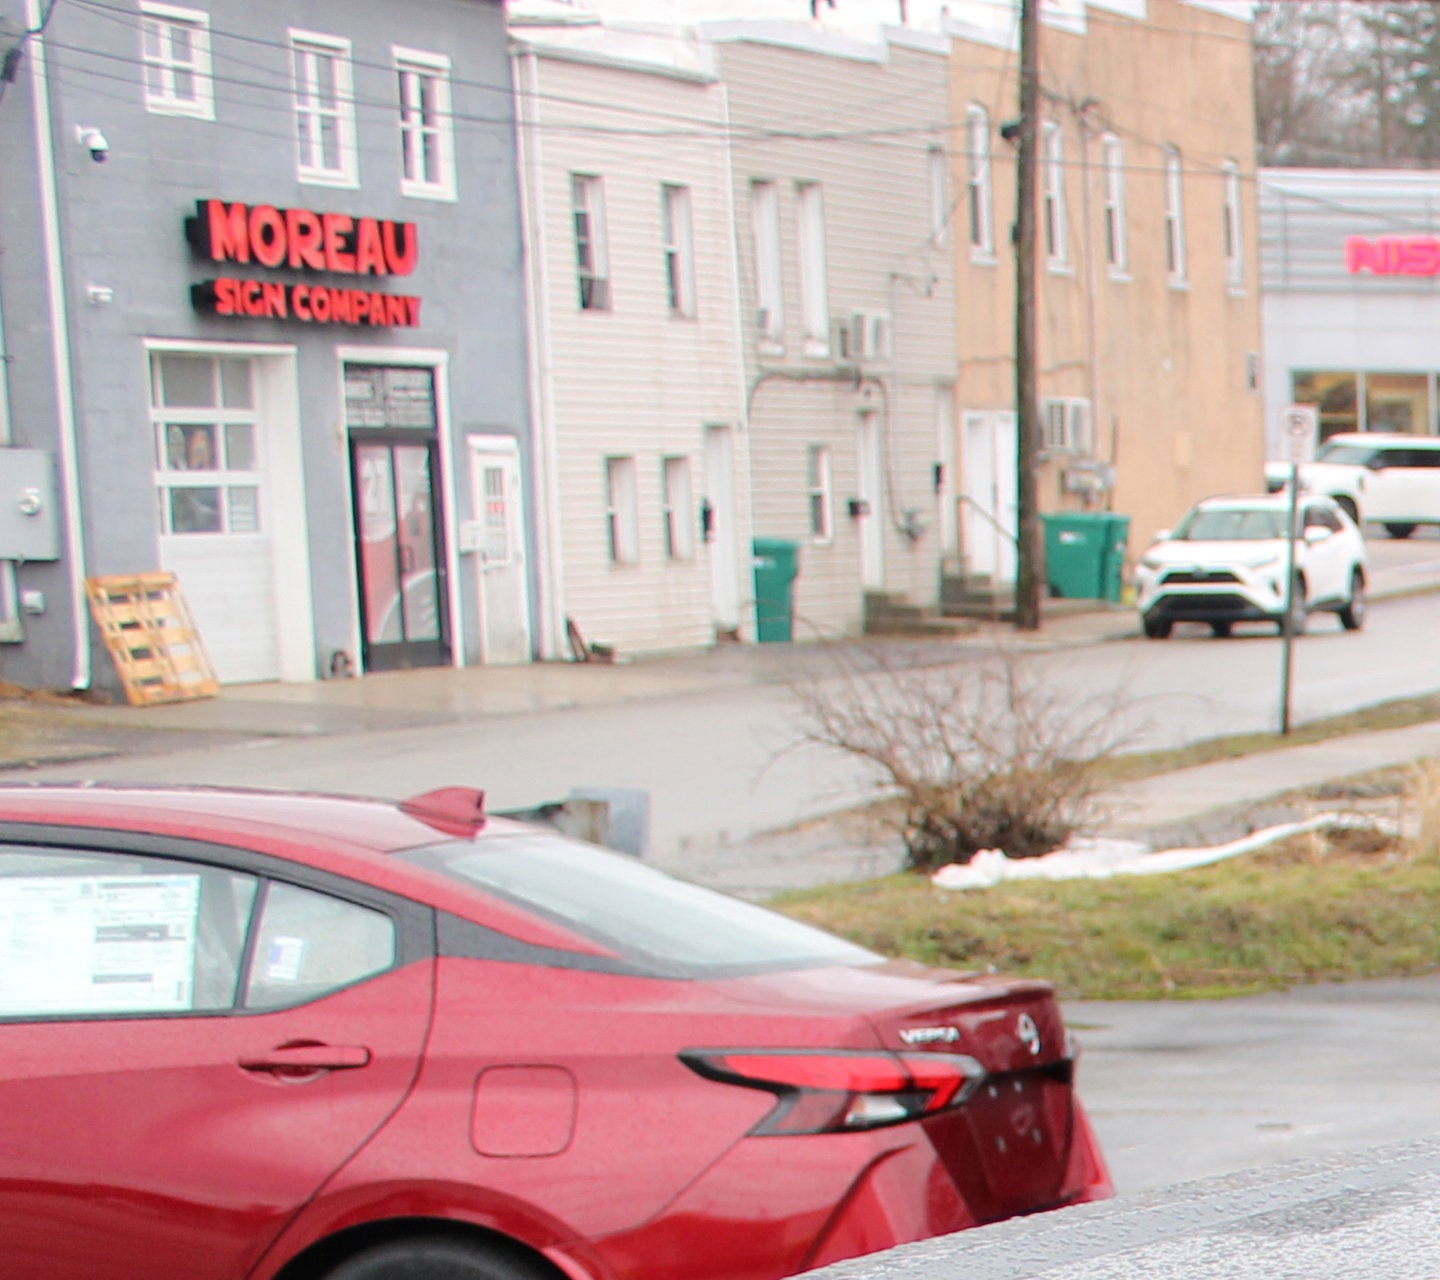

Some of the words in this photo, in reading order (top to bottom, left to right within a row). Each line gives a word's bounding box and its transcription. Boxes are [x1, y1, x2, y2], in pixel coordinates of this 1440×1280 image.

[207, 198, 418, 276] MOREAU
[213, 277, 288, 319] SIGN
[291, 284, 422, 328] COMPANY
